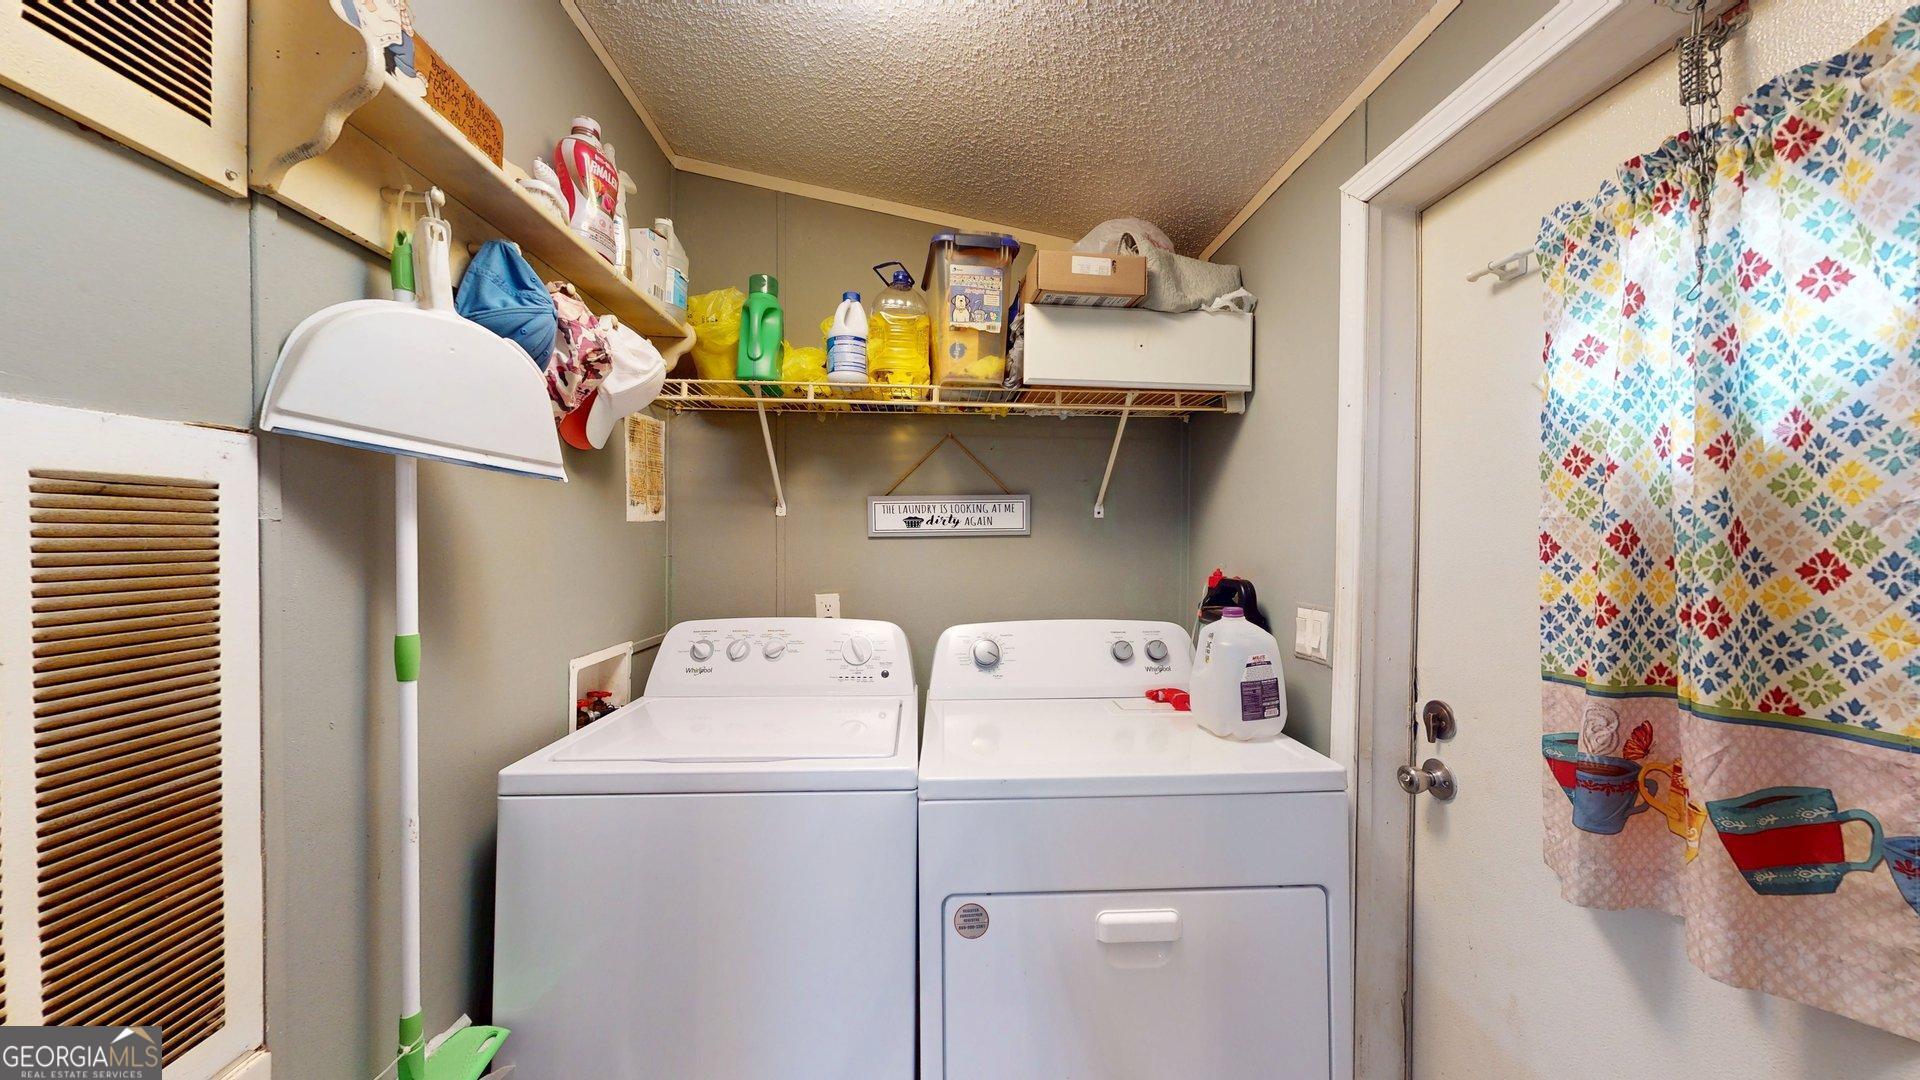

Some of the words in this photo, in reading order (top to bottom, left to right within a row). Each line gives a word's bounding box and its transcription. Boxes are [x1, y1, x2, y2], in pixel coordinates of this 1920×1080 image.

[882, 504, 895, 514] THE
[898, 504, 937, 514] LAUNDRY
[940, 504, 948, 514] IS
[950, 503, 988, 514] LOOKING
[991, 503, 1001, 514] AT
[1004, 503, 1015, 513] ME
[926, 514, 961, 528] dirty
[964, 516, 993, 526] AGAIN
[685, 666, 713, 676] Whirlpool
[1144, 664, 1172, 675] Whirlpool
